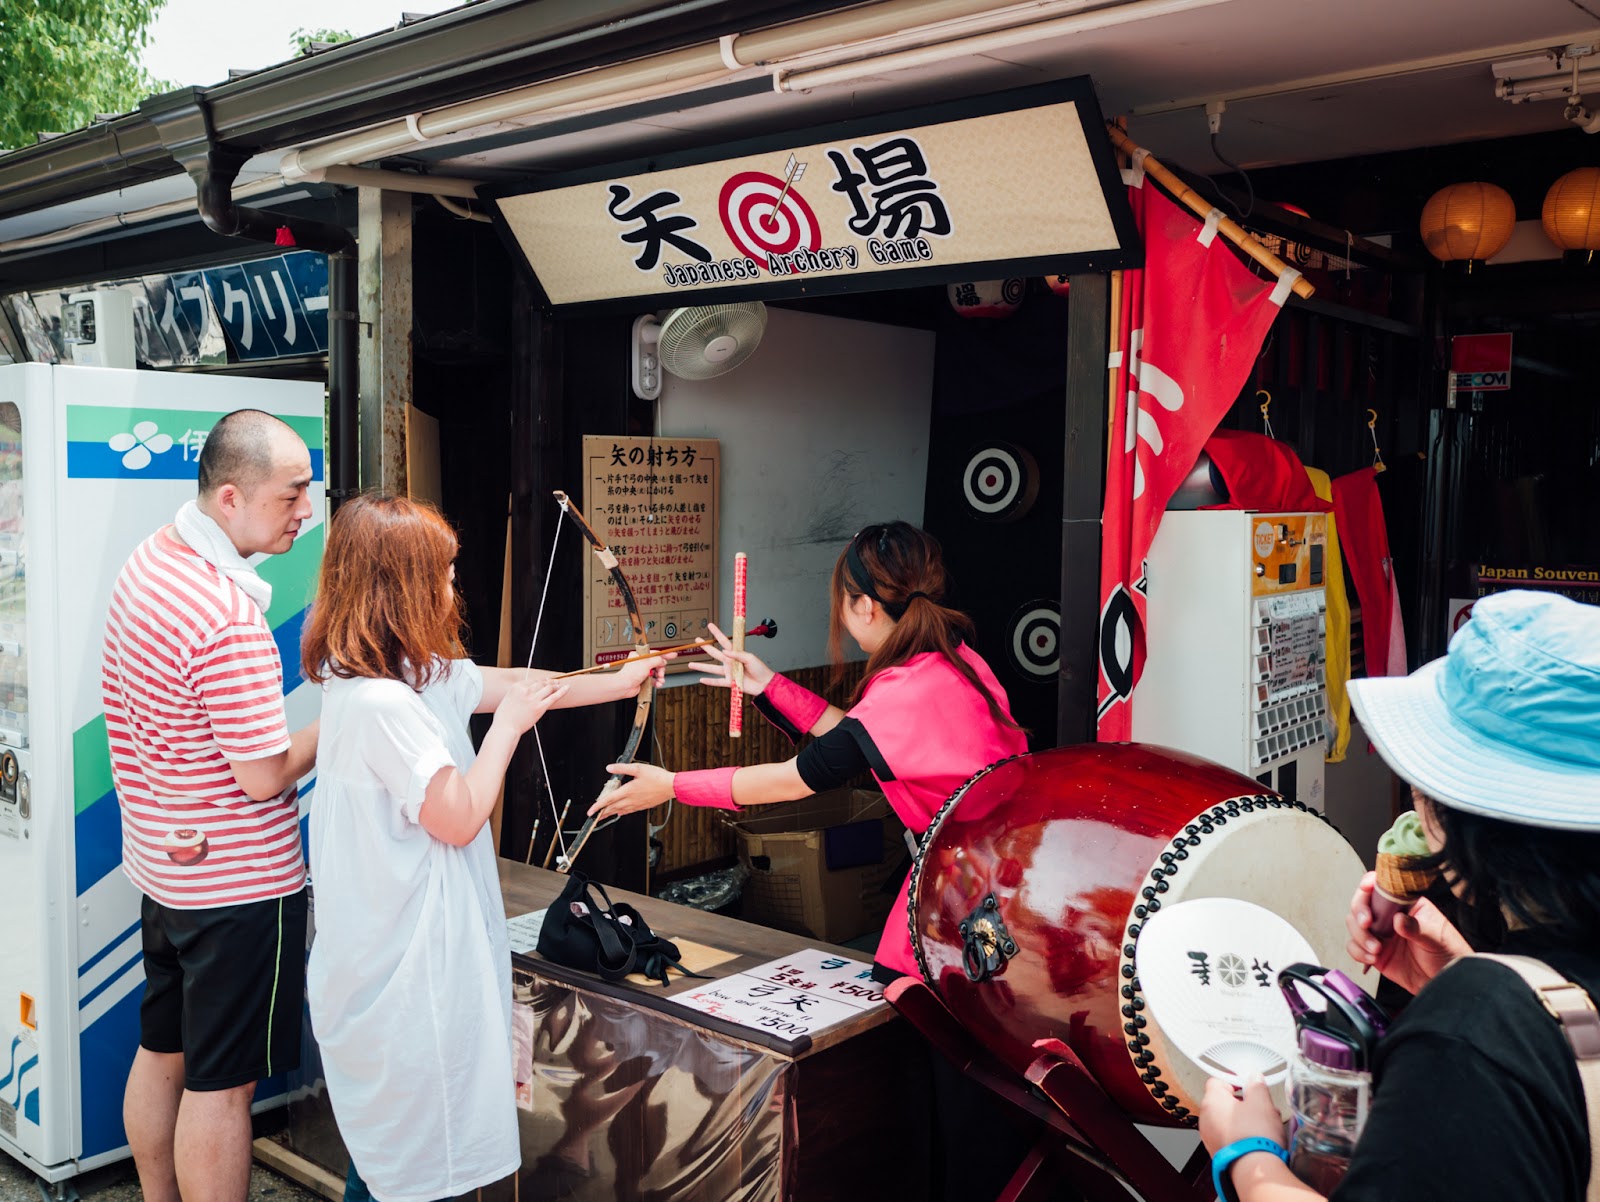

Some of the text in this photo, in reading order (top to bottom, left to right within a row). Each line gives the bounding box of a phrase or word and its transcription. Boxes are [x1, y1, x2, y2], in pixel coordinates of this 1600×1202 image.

[607, 137, 951, 270] 矢 場
[664, 237, 933, 287] Japanese Archery Game
[1453, 373, 1507, 387] SECOM
[610, 444, 697, 467] 矢の射ち方
[1256, 534, 1273, 545] TICKET
[1478, 565, 1599, 581] Japan Souven
[829, 981, 885, 1002] ¥500
[709, 989, 732, 1000] bow
[735, 999, 760, 1007] and
[759, 1005, 794, 1018] arrow
[756, 1015, 809, 1035] ¥500
